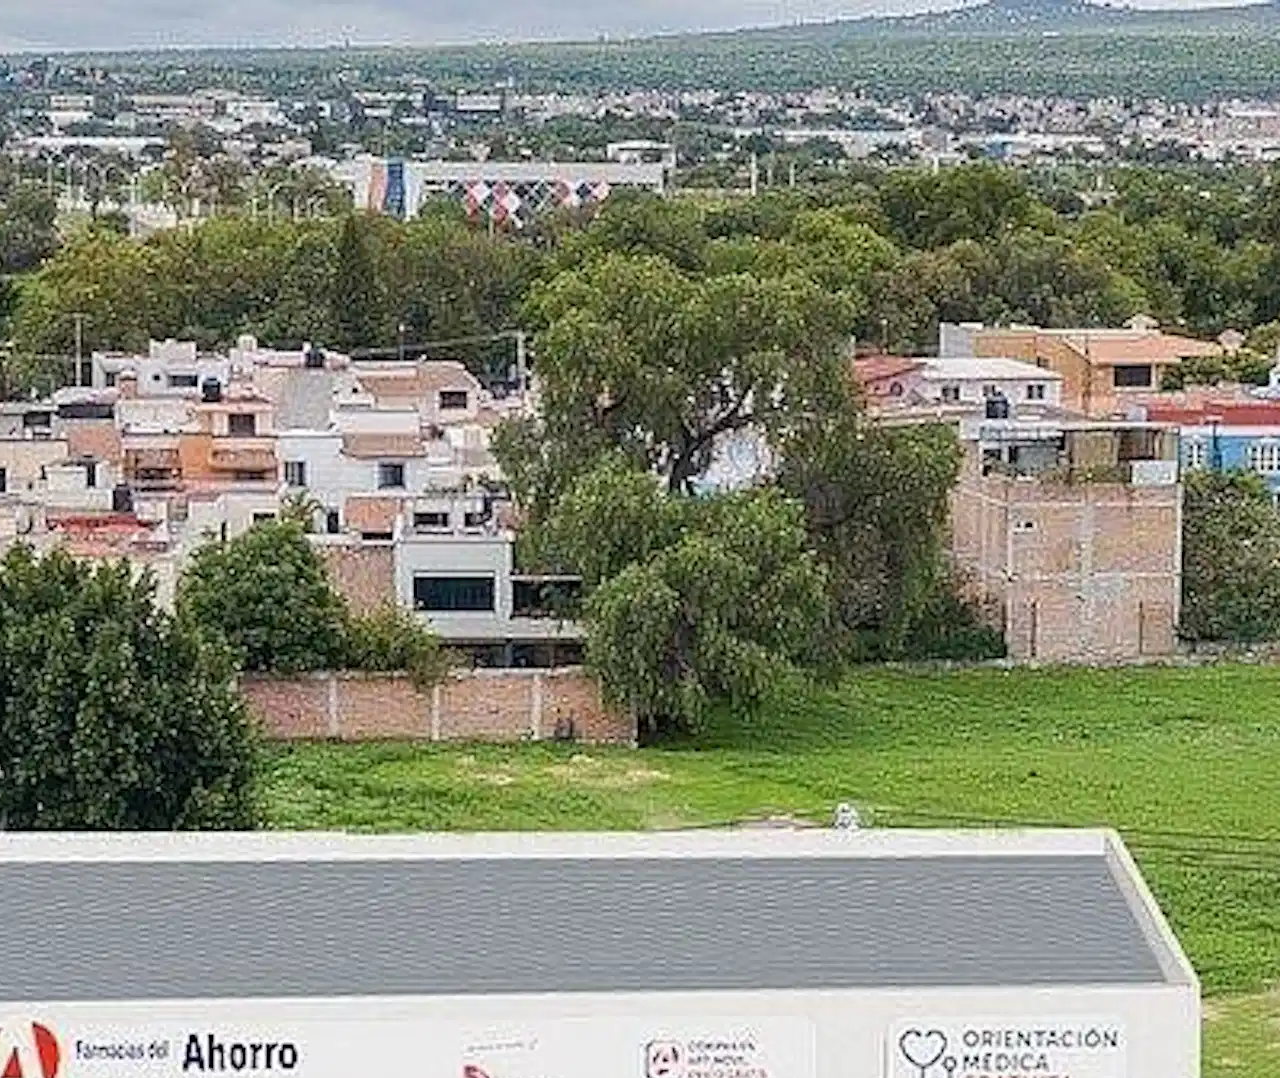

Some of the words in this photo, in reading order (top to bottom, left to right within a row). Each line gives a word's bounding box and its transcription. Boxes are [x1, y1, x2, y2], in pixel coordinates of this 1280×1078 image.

[76, 1040, 145, 1060] Farmacias
[147, 1040, 170, 1060] del
[181, 1033, 298, 1072] Ahorro
